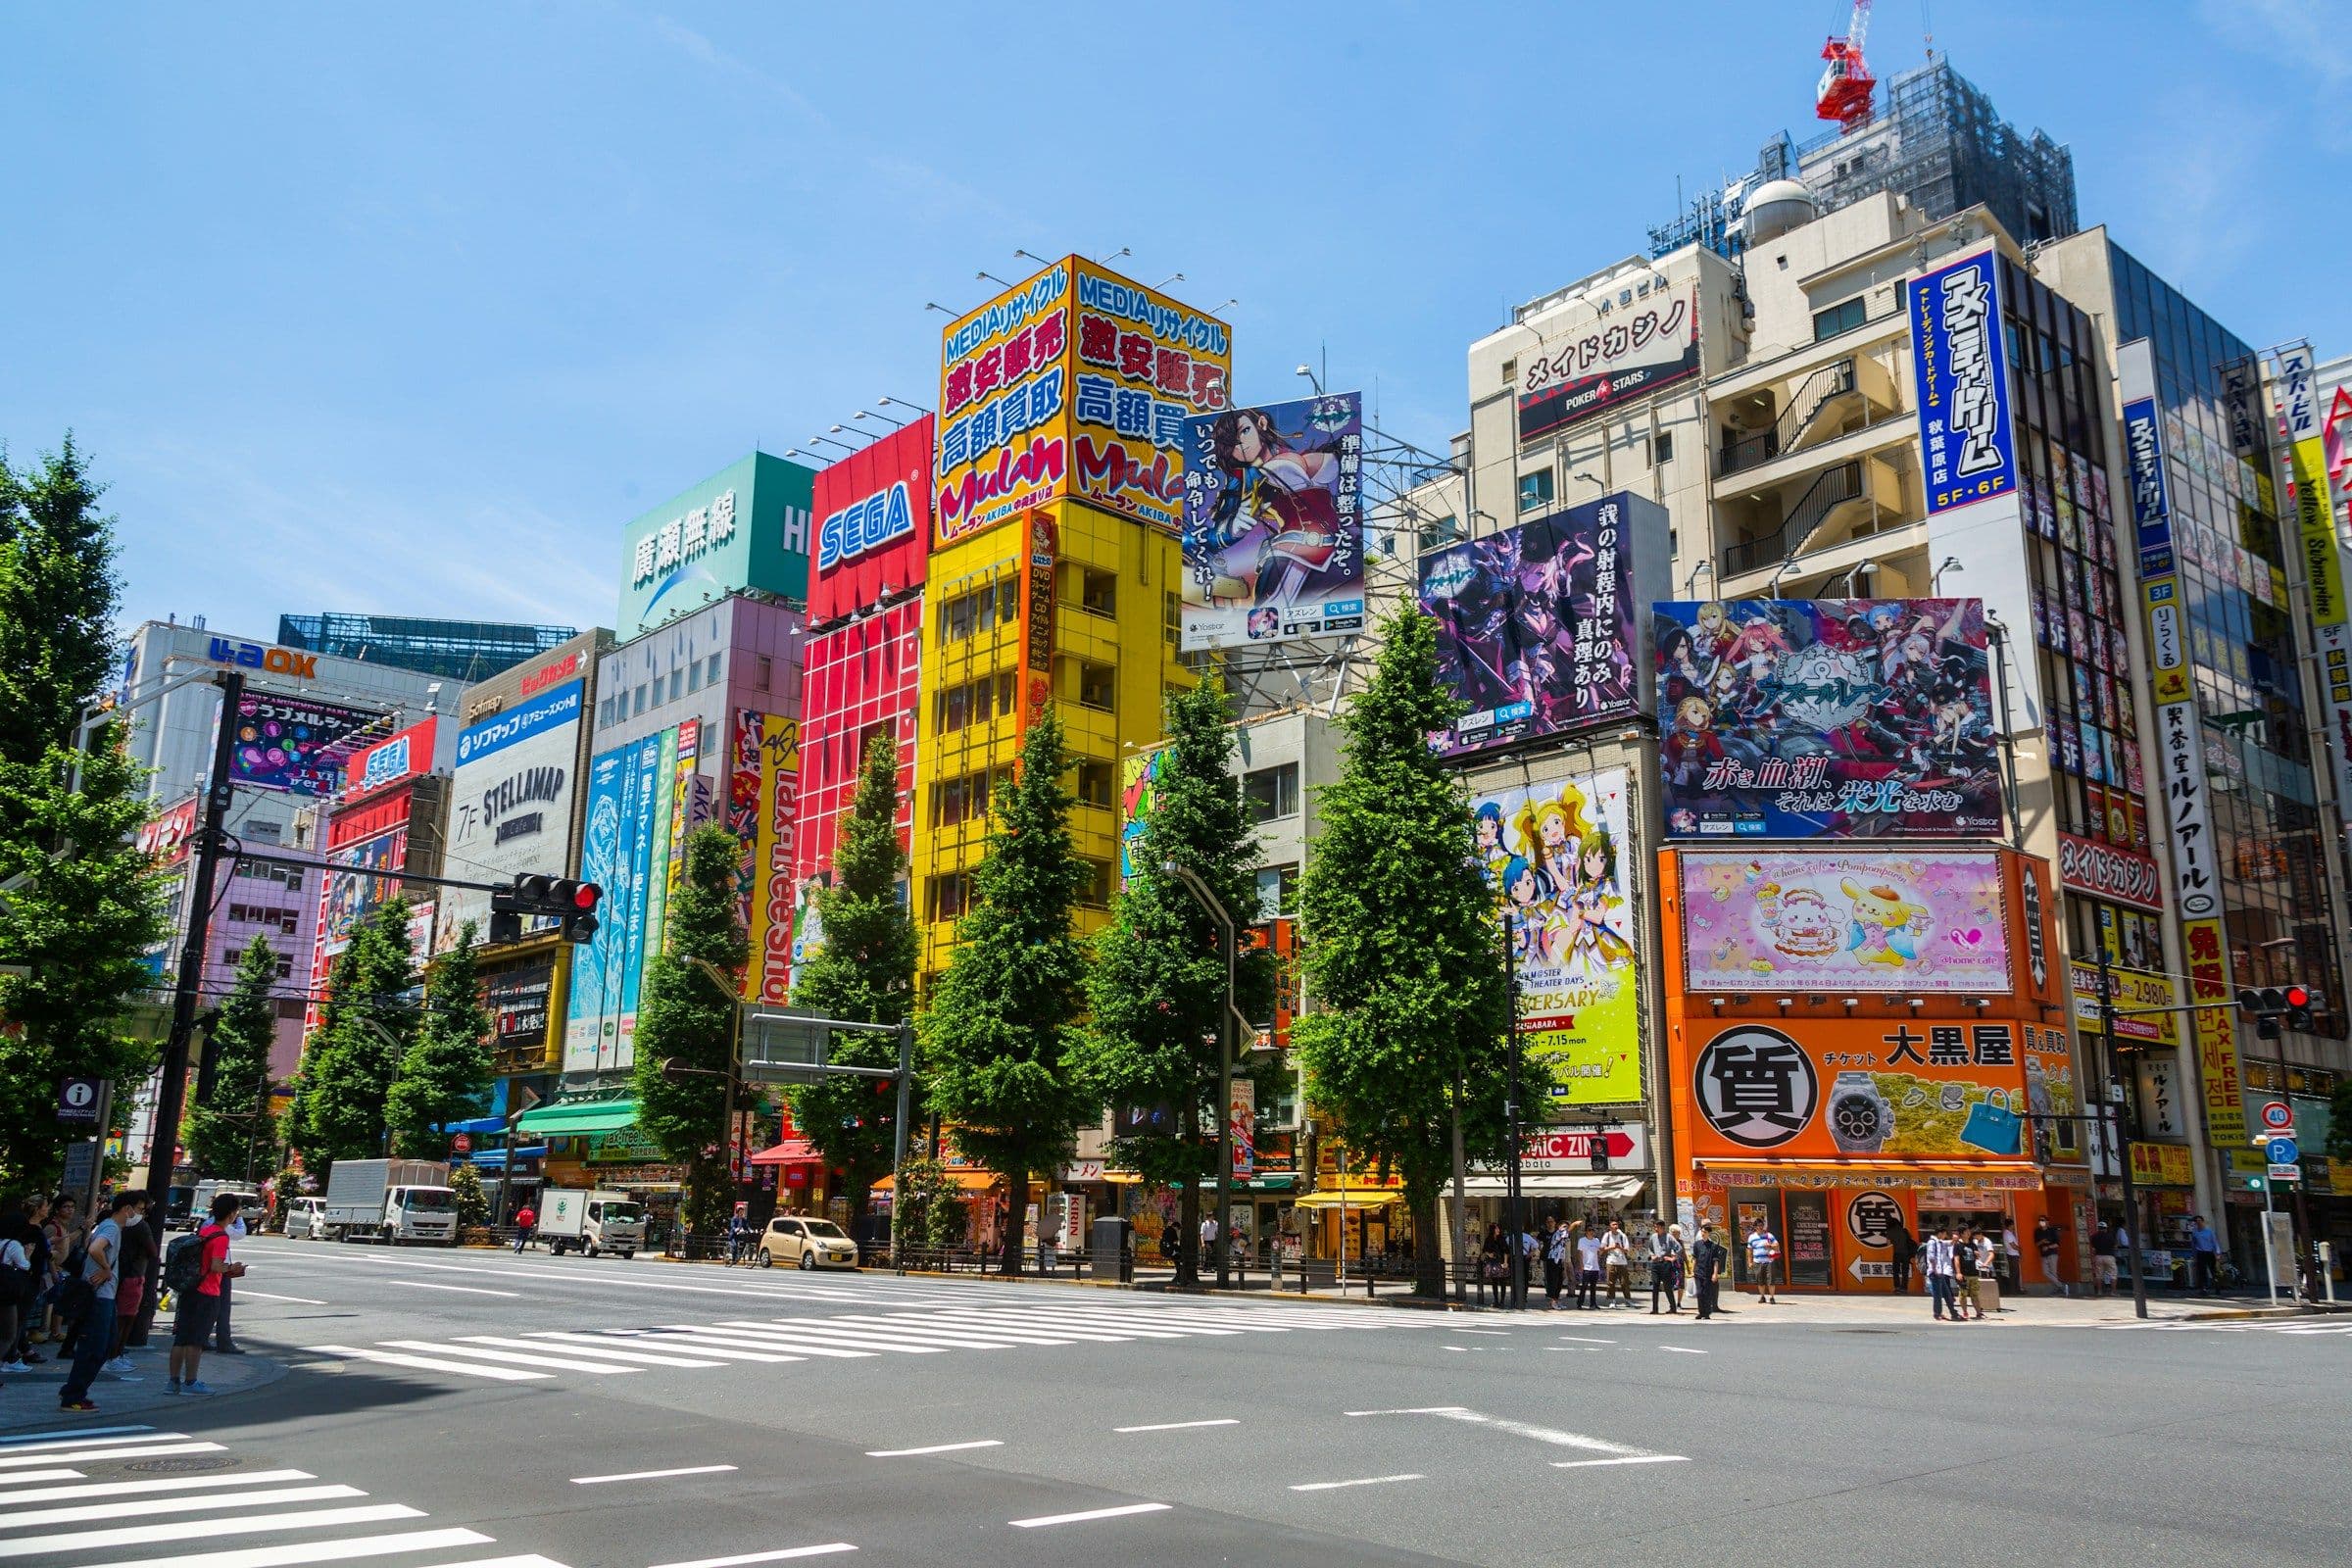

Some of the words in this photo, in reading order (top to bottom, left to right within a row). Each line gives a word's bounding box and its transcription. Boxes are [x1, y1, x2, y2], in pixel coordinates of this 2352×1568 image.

[945, 308, 1066, 415] 激安販売
[1079, 314, 1229, 410] 激安販売
[1527, 300, 1685, 391] メイドカジノ
[1921, 296, 1939, 400] トレーディングカードゲーム
[1566, 391, 1596, 410] POKER
[1612, 371, 1644, 392] STARS
[2285, 357, 2312, 432] スーパービル
[941, 367, 1063, 476] 高額買取
[1196, 424, 1219, 489] いつでも
[1929, 419, 1947, 485] 秋葉原店
[938, 437, 1065, 538] Mulan
[1091, 488, 1137, 513] ムーラン
[1138, 505, 1172, 525] AKIBA
[1333, 434, 1361, 577] 準備は整ったぞ。
[819, 482, 913, 571] SEGA
[950, 514, 985, 539] ムーラン
[985, 503, 1013, 522] AKIBA
[1032, 567, 1051, 581] DVD
[1592, 503, 1617, 685] 我の射程内にのみ
[2152, 586, 2171, 601] 3F
[1030, 624, 1050, 637] アニメ
[1034, 602, 1047, 613] CD
[1287, 608, 1317, 618] アズレン
[1342, 603, 1357, 612] 検索
[2324, 626, 2340, 637] 5F
[1574, 618, 1593, 709] 真理あり
[2158, 609, 2175, 666] りらくる
[259, 705, 353, 729] ラブメルシー
[468, 696, 502, 718] Sofmap
[473, 714, 520, 750] ソフマップ
[367, 737, 410, 789] SEGA
[483, 766, 564, 826] STELLAMAP
[1775, 780, 1963, 814] それは栄光を求む
[1966, 815, 1998, 826] Yostar
[458, 805, 478, 842] 7F
[2173, 779, 2210, 890] ルノアール
[2061, 840, 2156, 901] メイドカジノ
[1531, 980, 1563, 990] THEATER
[1565, 976, 1585, 986] DAYS
[2188, 926, 2226, 999] 免税
[1823, 1052, 1878, 1066] チケット
[1883, 1024, 2015, 1066] 大黒屋
[1708, 1044, 1803, 1134] 質
[2222, 1052, 2240, 1107] FREE
[2269, 1110, 2286, 1121] 40
[1061, 1162, 1100, 1178] ラーメン
